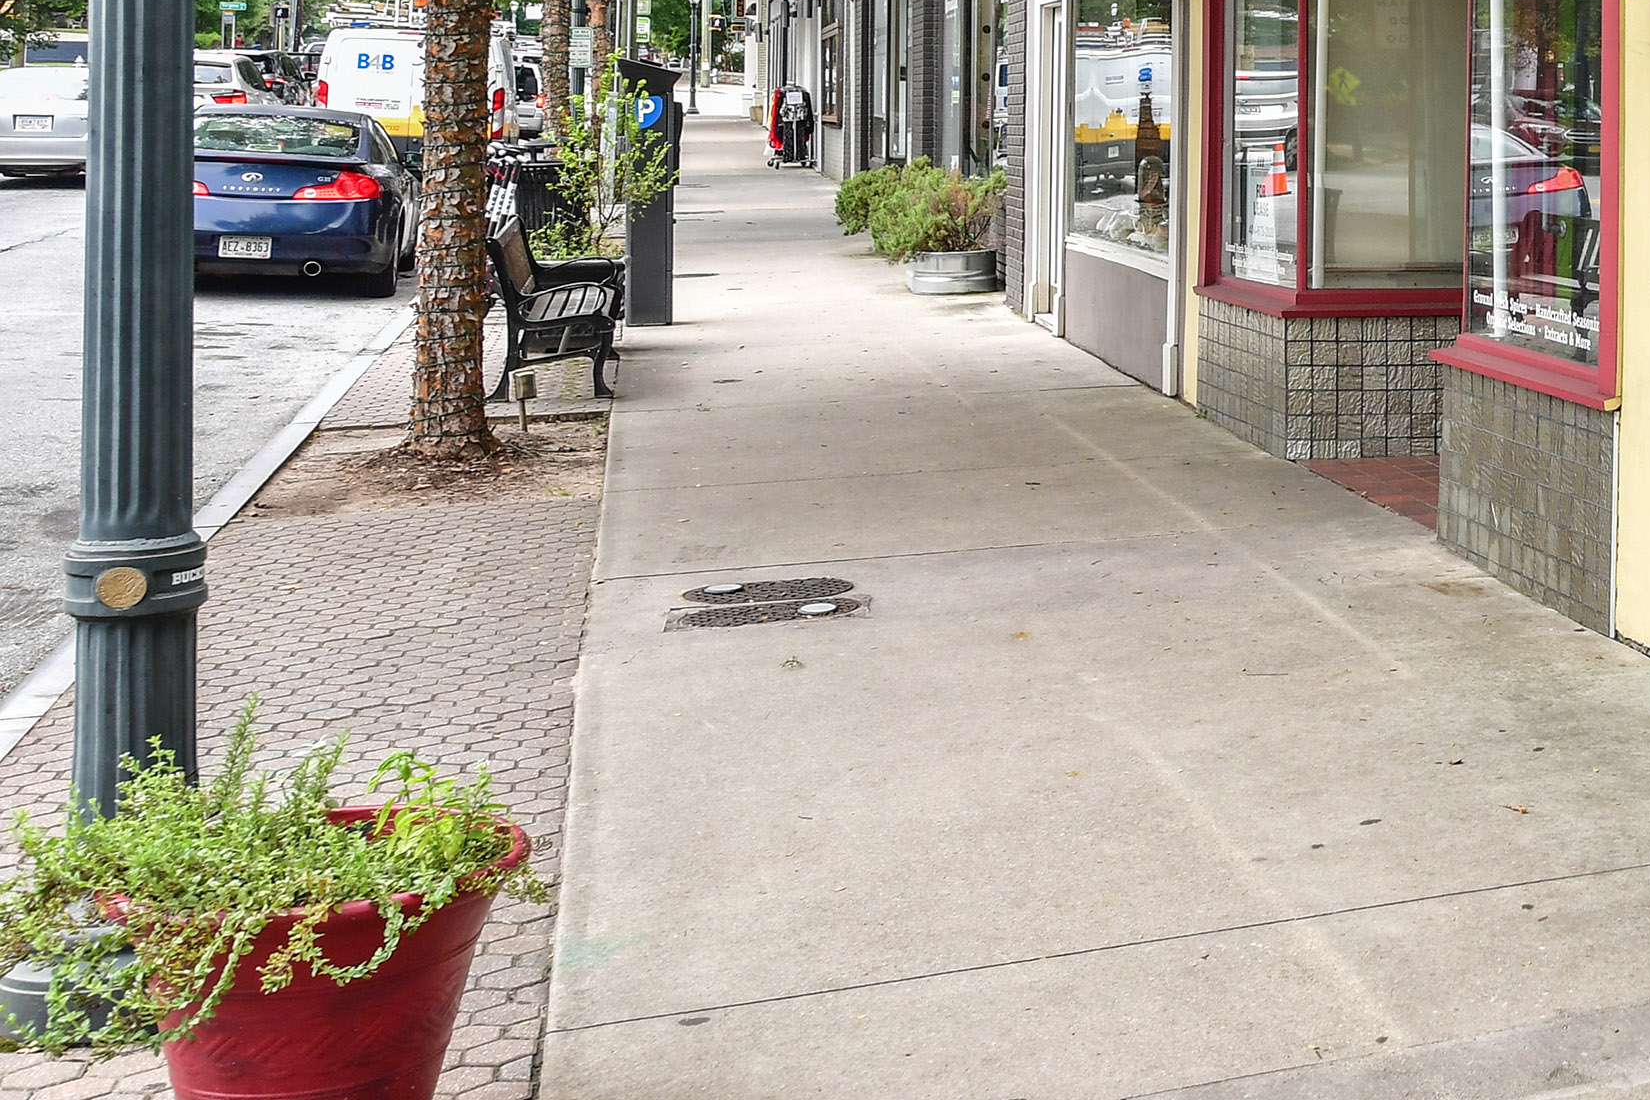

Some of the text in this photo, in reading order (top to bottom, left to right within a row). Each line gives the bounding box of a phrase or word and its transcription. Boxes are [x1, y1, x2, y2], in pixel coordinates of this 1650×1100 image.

[357, 53, 395, 70] B4B
[637, 99, 655, 123] P
[1509, 297, 1528, 315] Spices
[1535, 303, 1572, 326] Handcrafted
[1507, 316, 1536, 336] Selections
[1544, 325, 1568, 345] Extracts
[1575, 332, 1591, 351] More
